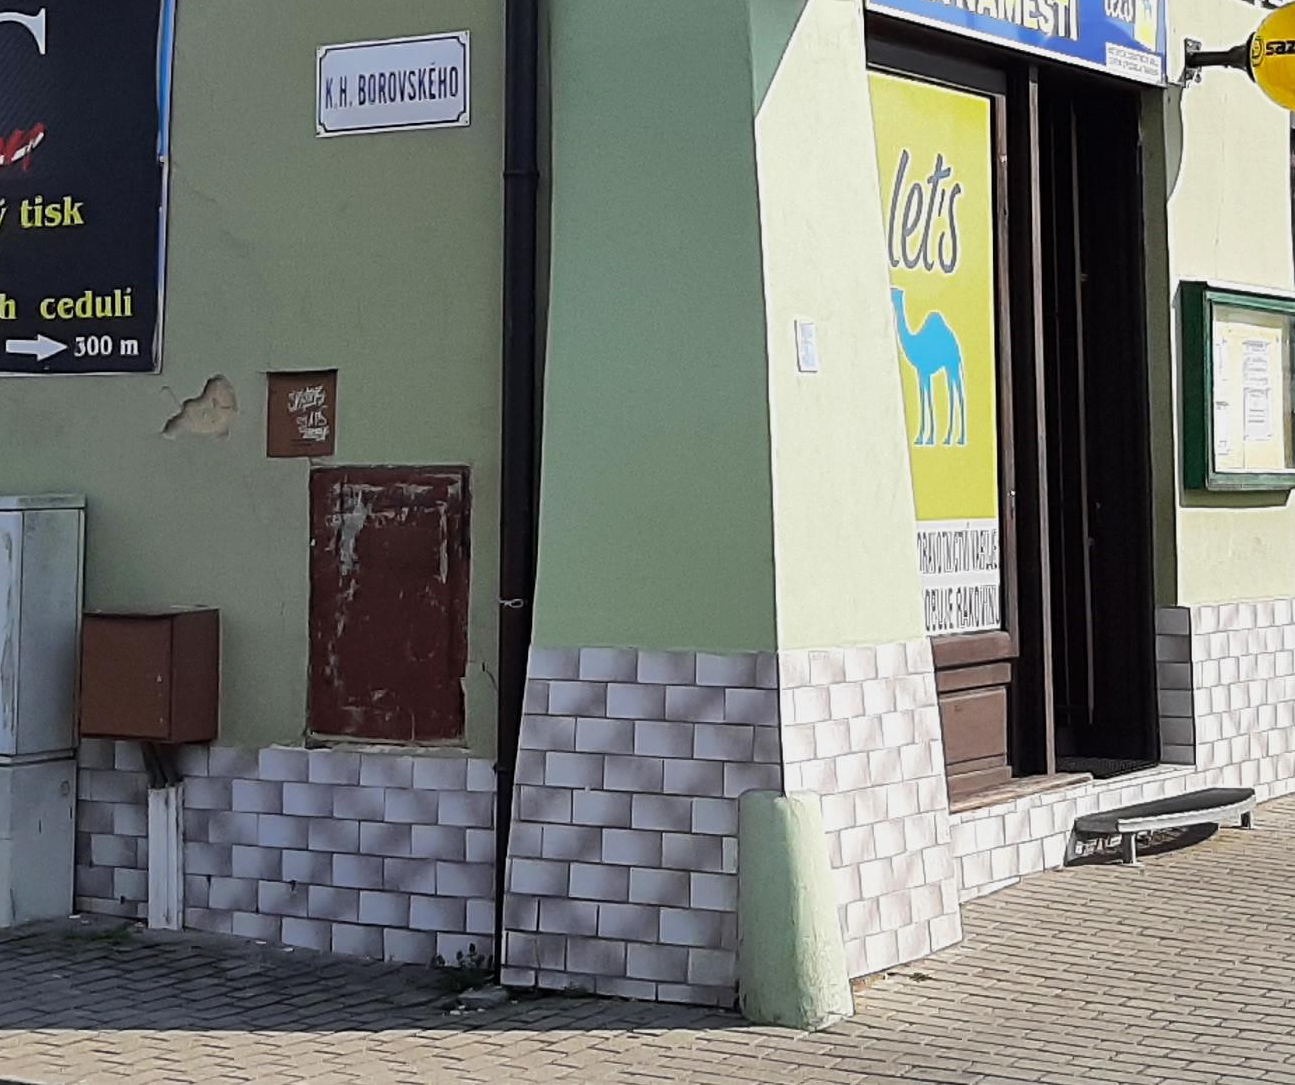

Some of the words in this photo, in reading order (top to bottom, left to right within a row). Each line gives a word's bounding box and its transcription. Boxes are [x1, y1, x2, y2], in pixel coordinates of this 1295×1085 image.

[358, 62, 459, 106] BOROVSKÉHO
[20, 195, 85, 229] tisk
[888, 149, 961, 273] let's
[73, 334, 112, 357] 300
[120, 339, 139, 357] m
